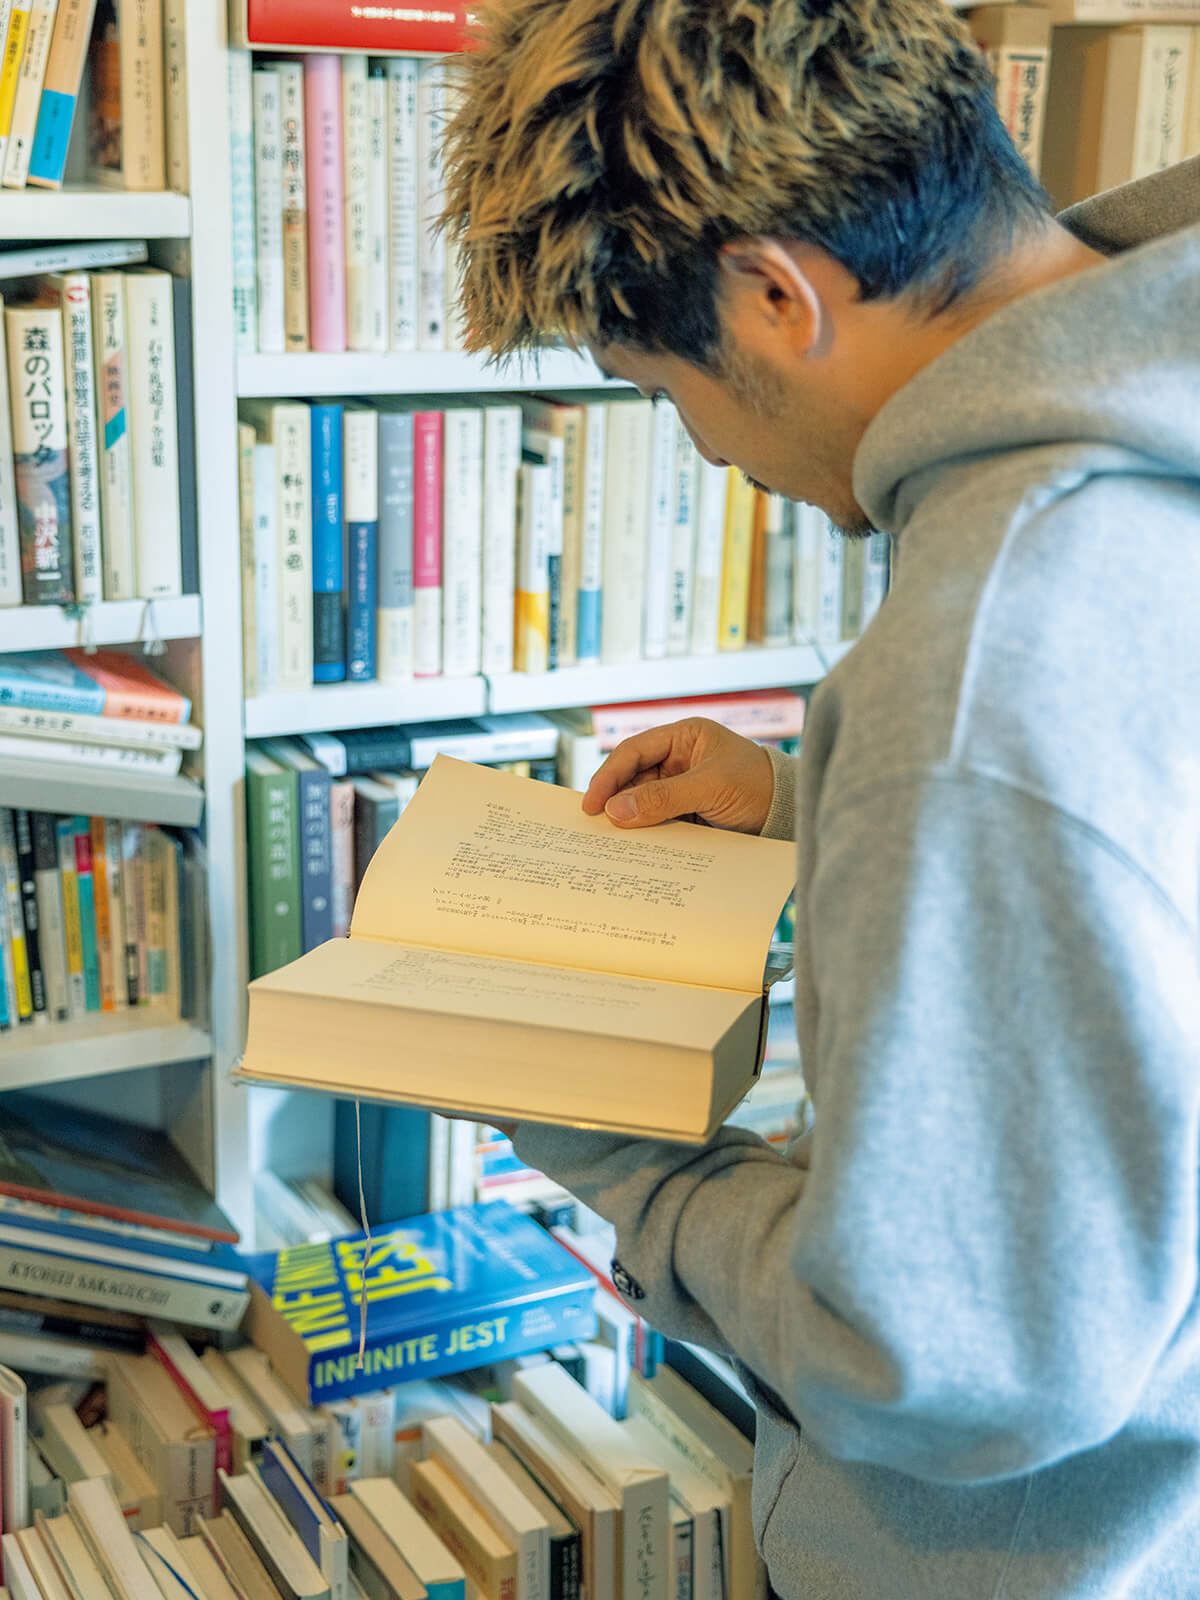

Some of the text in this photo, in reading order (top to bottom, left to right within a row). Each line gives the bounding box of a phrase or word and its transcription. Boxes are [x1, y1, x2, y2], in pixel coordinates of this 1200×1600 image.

[23, 326, 57, 468] 森のバロック
[336, 1231, 454, 1306] JEST
[313, 1333, 439, 1388] INFINITE
[445, 1316, 510, 1356] JEST
